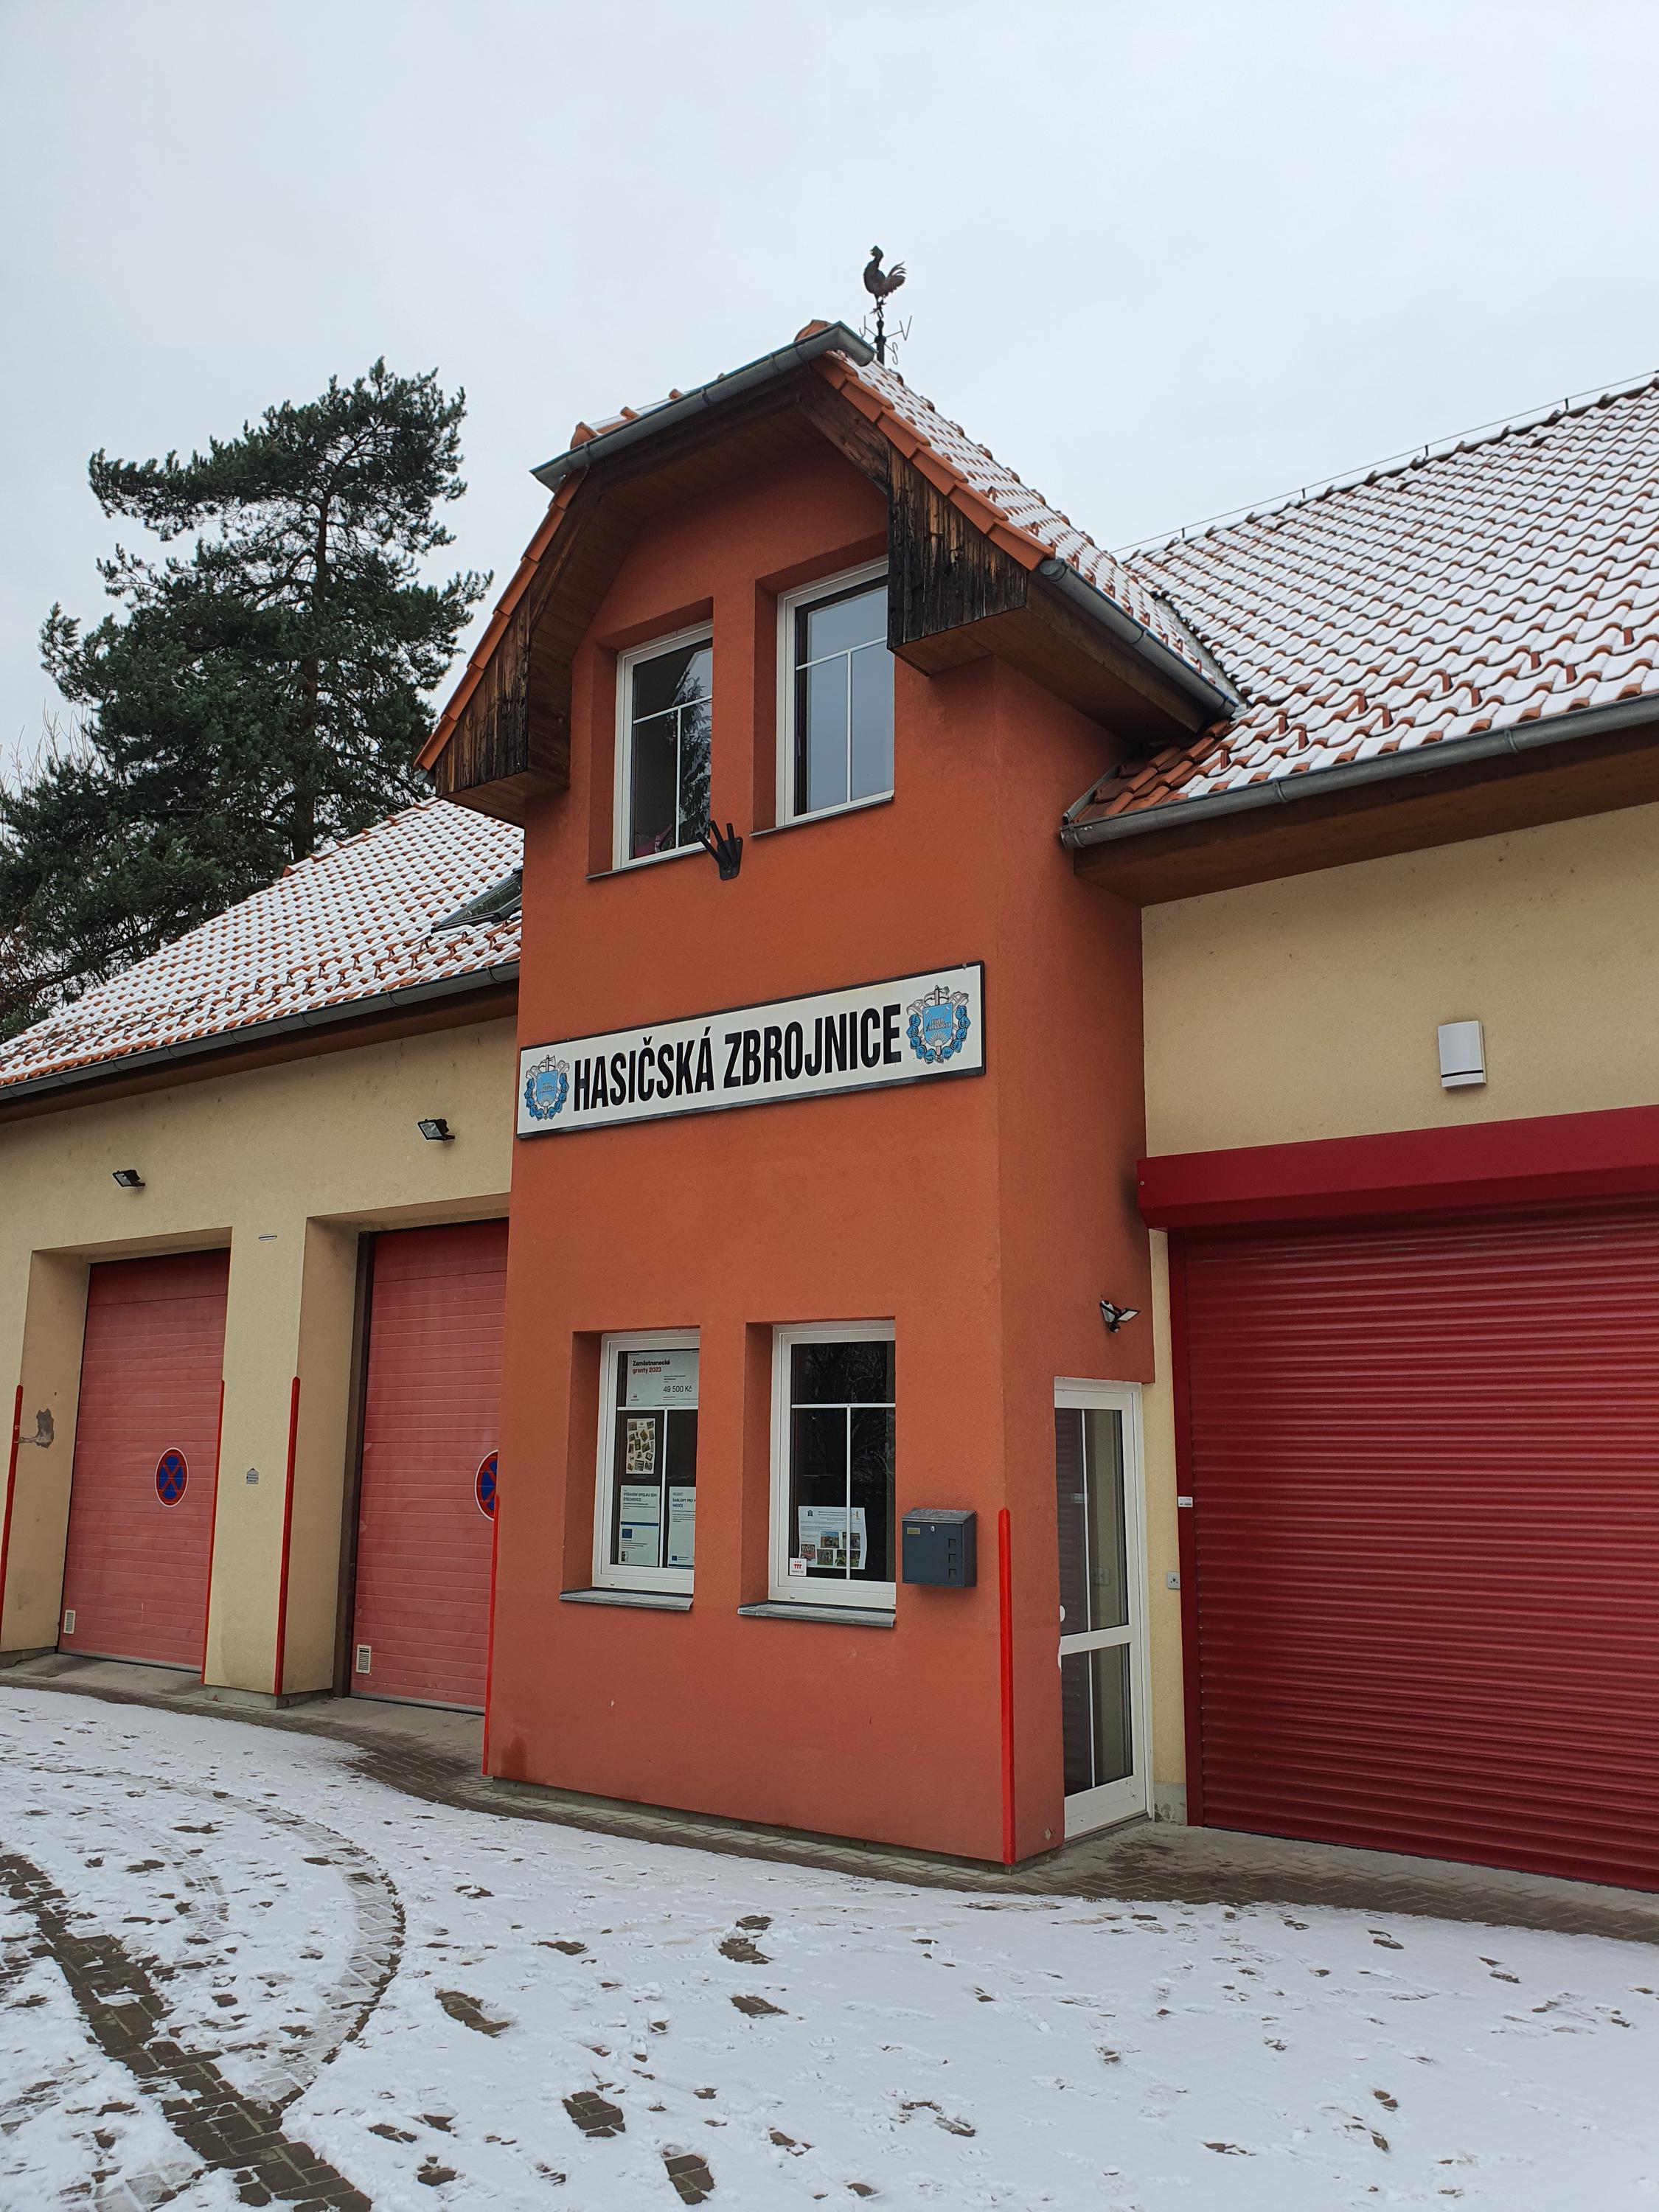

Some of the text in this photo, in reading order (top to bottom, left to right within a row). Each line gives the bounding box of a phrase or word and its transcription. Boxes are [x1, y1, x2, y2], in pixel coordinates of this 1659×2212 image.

[574, 1004, 902, 1111] HASIČSKÁ ZBROJNICE
[684, 1385, 692, 1393] Kč
